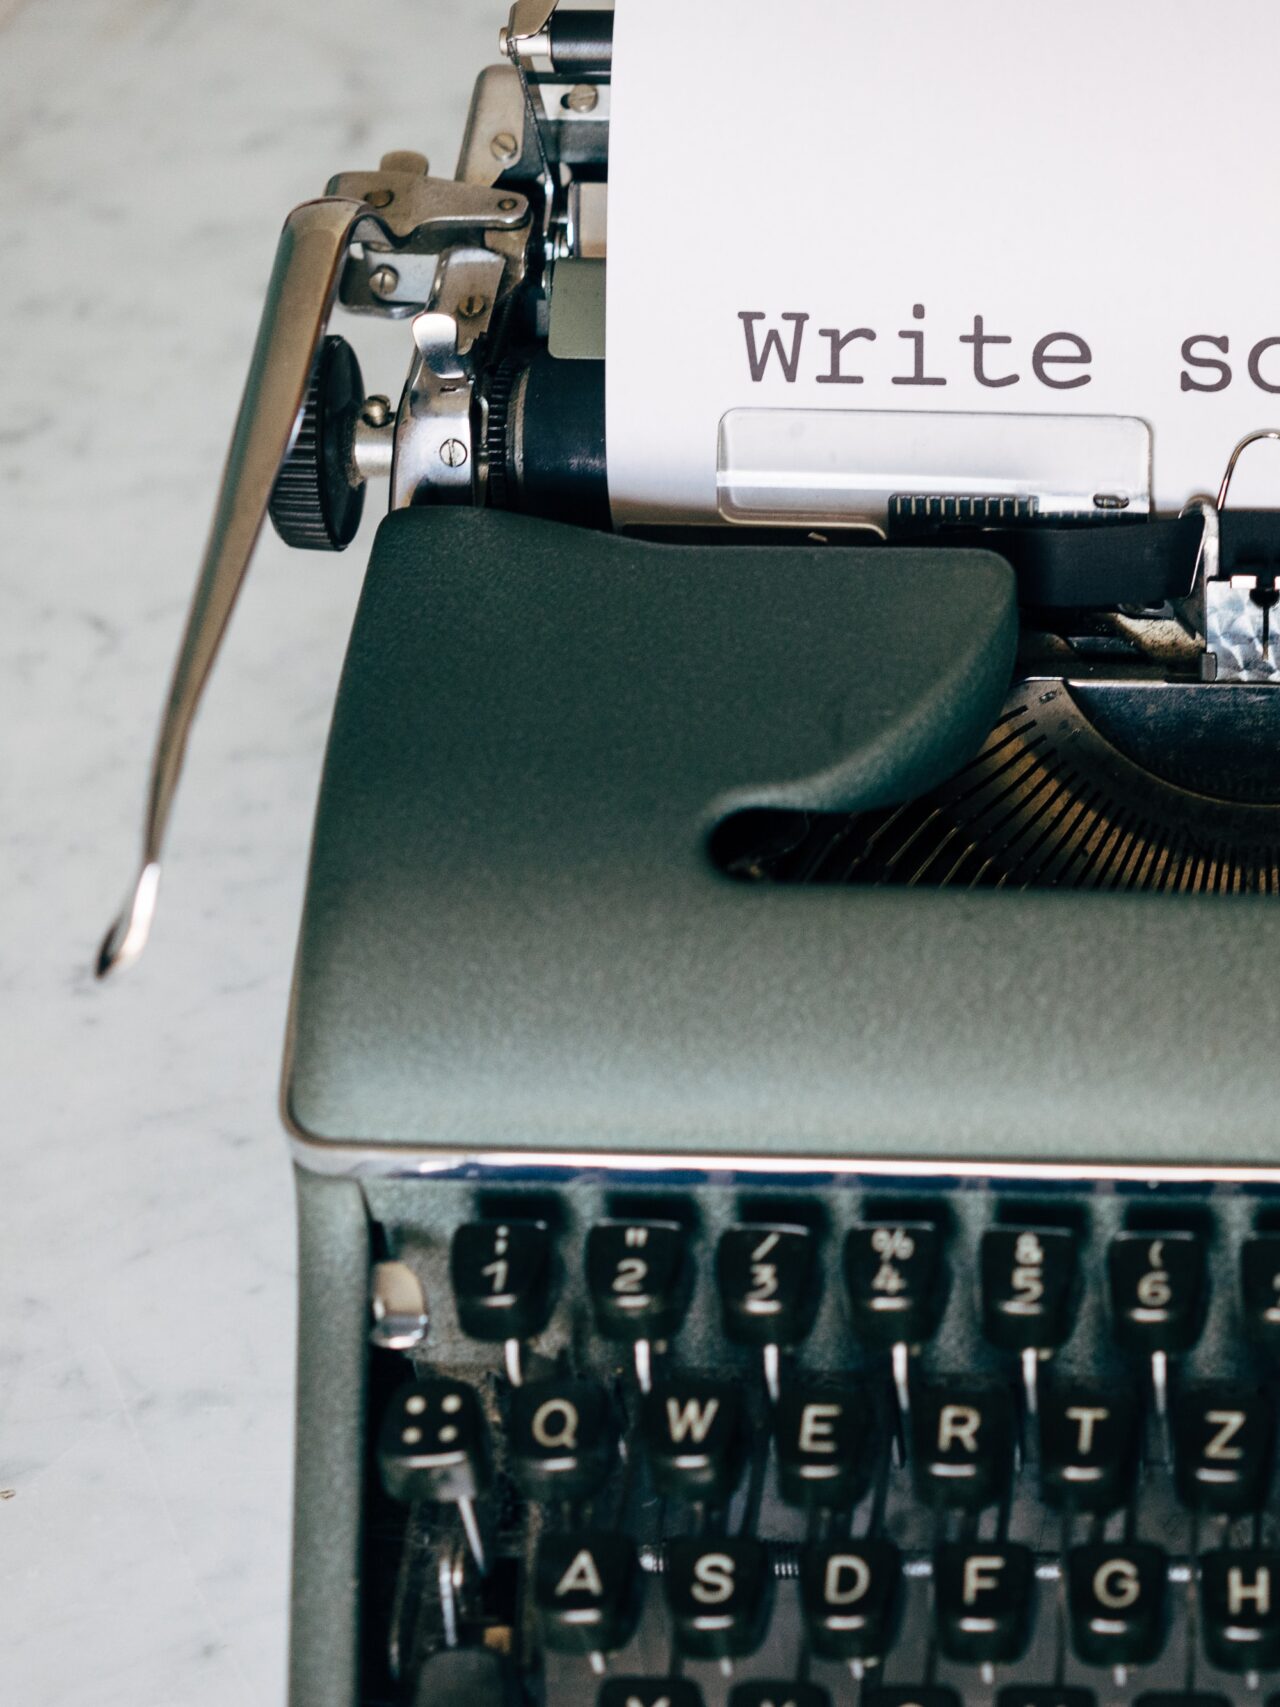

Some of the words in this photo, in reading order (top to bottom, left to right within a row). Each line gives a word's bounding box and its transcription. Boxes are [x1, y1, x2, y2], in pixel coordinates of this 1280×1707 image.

[738, 304, 1093, 389] Write
[873, 1228, 913, 1260] %
[484, 1260, 507, 1291] 1
[613, 1259, 646, 1292] 2
[748, 1265, 777, 1300] 3
[873, 1264, 904, 1292] 4
[1013, 1267, 1042, 1301] 5
[1138, 1272, 1170, 1305] 6
[533, 1399, 577, 1447] Q
[667, 1399, 718, 1441] W
[800, 1405, 838, 1452] E
[939, 1406, 980, 1450] R
[1068, 1408, 1106, 1452] T
[1206, 1411, 1244, 1458] Z
[557, 1551, 601, 1594] A
[693, 1554, 733, 1602] S
[826, 1555, 869, 1603] D
[965, 1557, 1003, 1602] F
[1094, 1560, 1139, 1607] G
[1229, 1569, 1269, 1612] H
